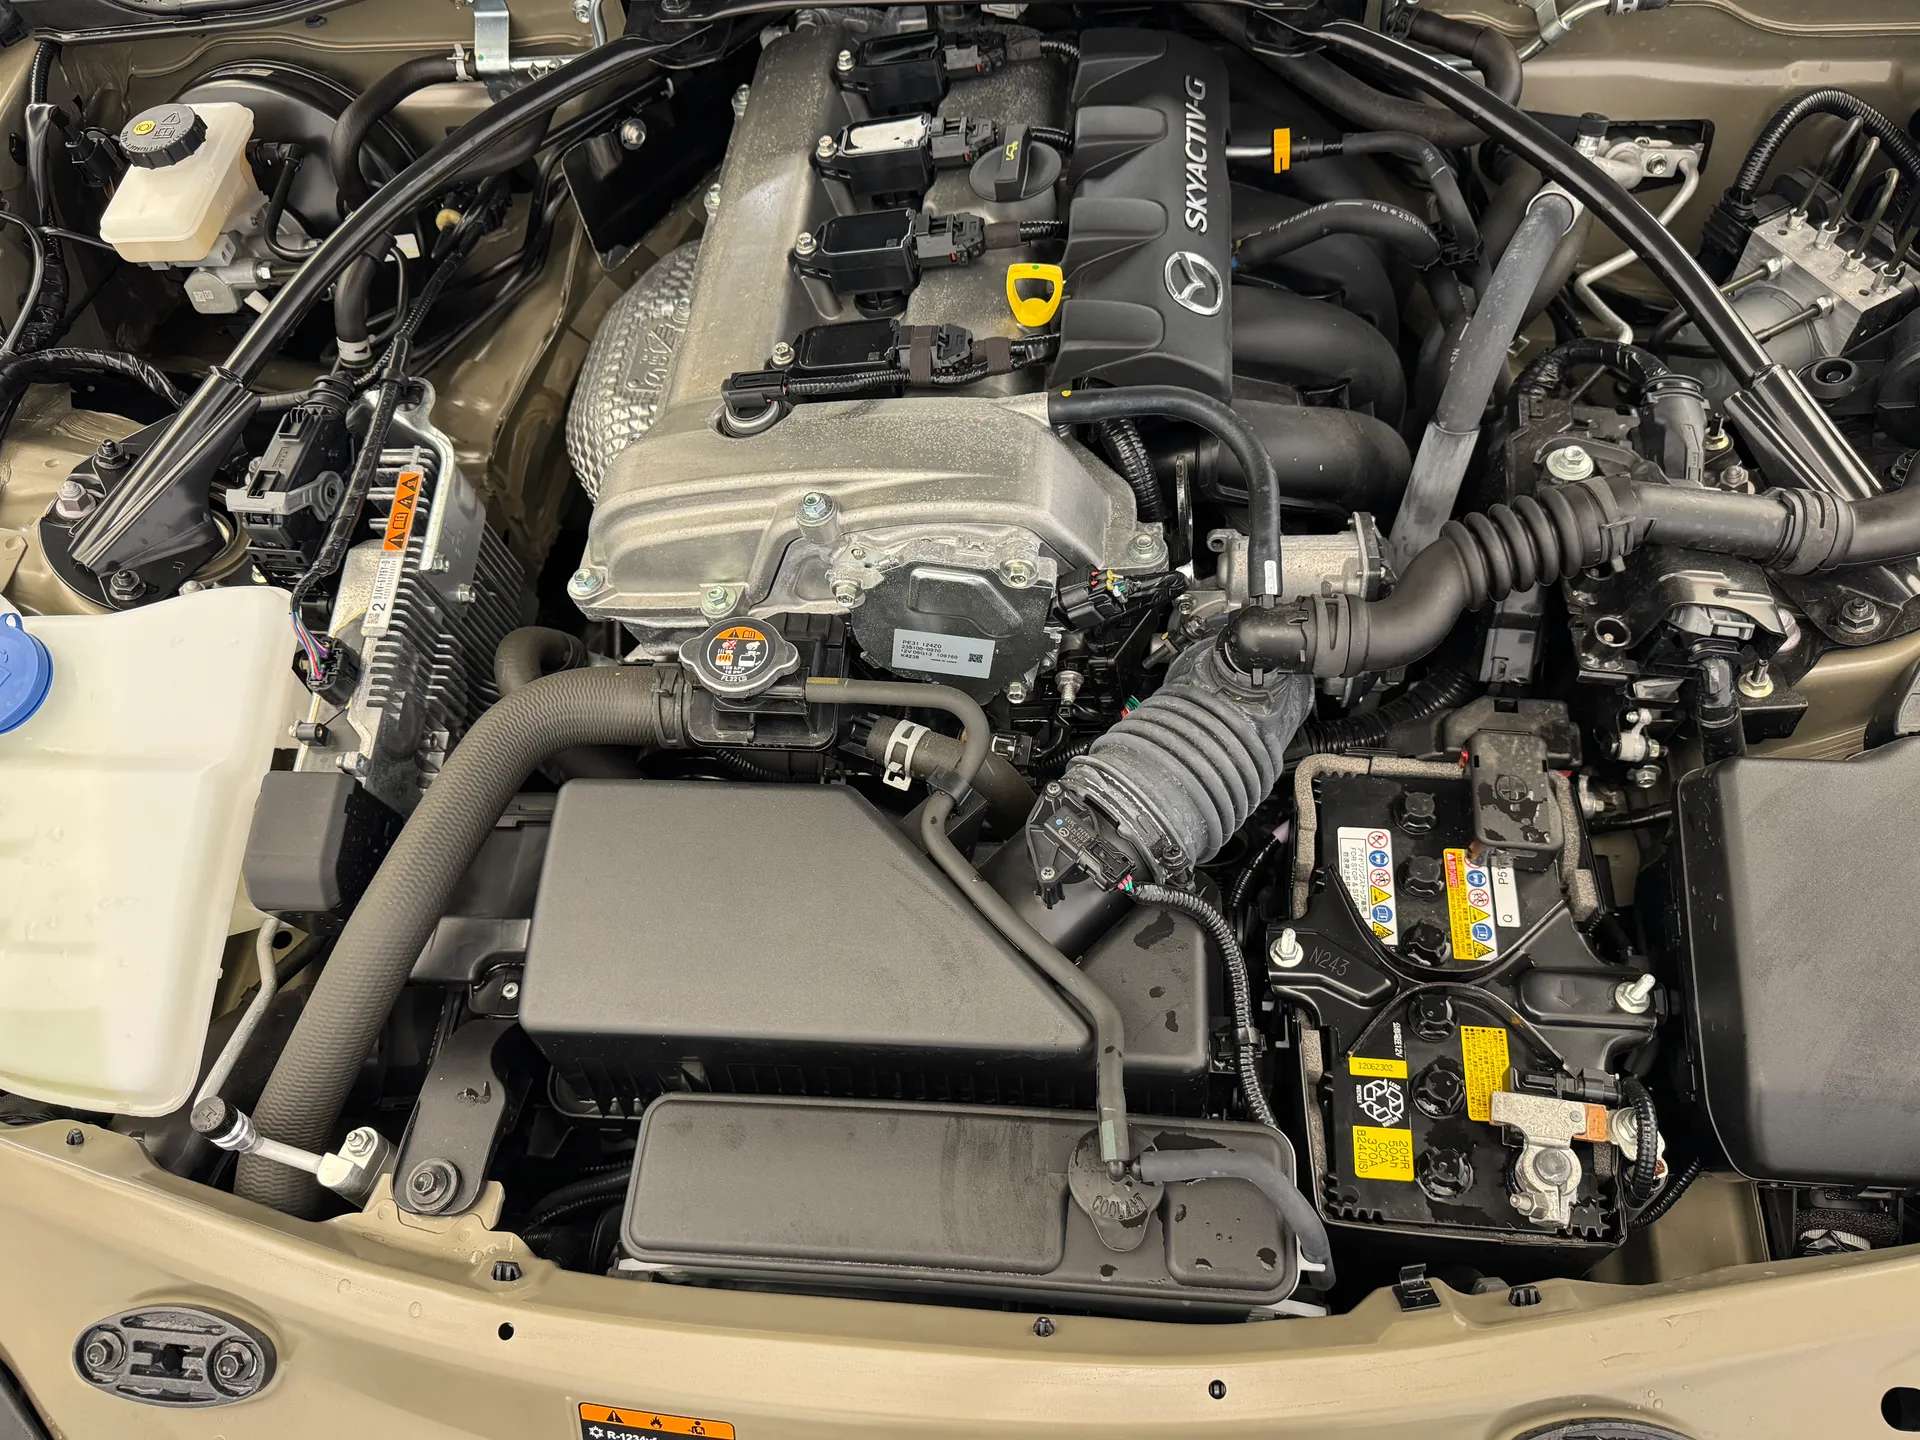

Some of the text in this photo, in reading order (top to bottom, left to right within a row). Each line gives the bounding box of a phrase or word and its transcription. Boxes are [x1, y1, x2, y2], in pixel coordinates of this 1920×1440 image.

[1185, 75, 1207, 233] SKYACTIV-G
[372, 603, 386, 611] 2
[1351, 860, 1359, 880] STOP
[1497, 866, 1513, 923] Q P5
[1309, 945, 1351, 976] N243
[1356, 1129, 1368, 1173] B24(JIS)
[1367, 1138, 1378, 1167] 370A
[1377, 1142, 1388, 1164] CCA
[1388, 1140, 1399, 1168] 50Ah
[1399, 1140, 1410, 1170] 20HR
[1092, 1193, 1147, 1221] COOLANT
